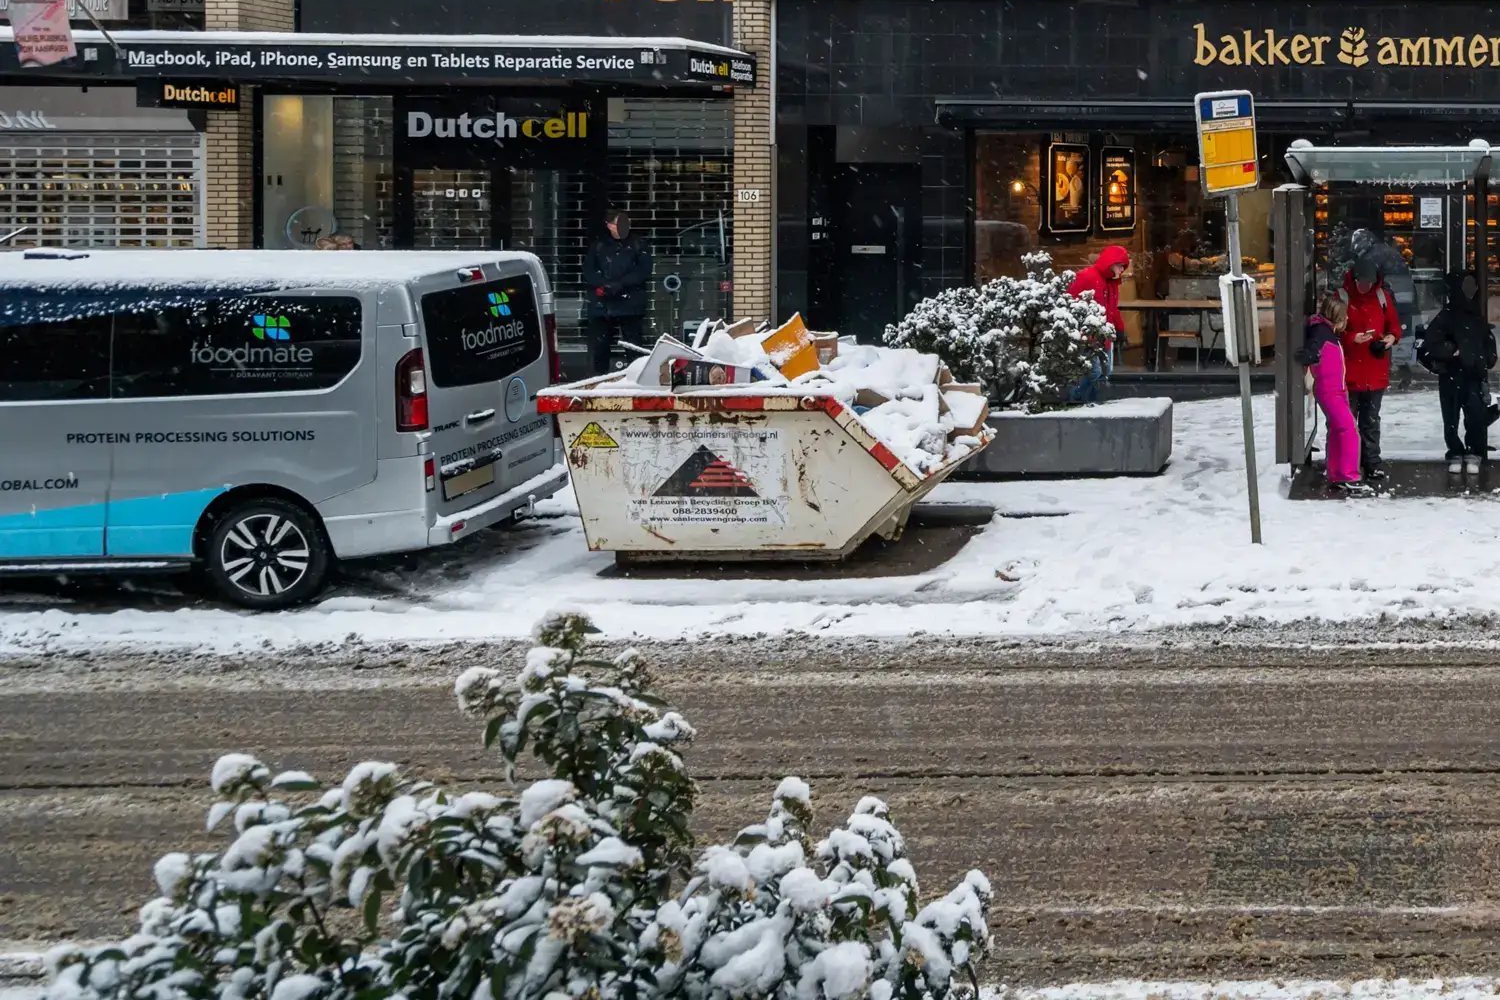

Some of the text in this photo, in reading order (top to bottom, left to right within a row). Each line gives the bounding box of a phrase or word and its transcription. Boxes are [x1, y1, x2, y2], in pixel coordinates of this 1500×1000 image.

[1194, 23, 1331, 66] bakker
[128, 50, 635, 71] Macbook, iPad, iPhone, Samsung en Tablets Reparatie Service
[690, 58, 728, 76] Dutchcell
[164, 84, 235, 104] Dutchcell
[408, 111, 587, 139] Dutchcell
[740, 190, 757, 201] 106
[461, 319, 525, 351] foodmate
[190, 340, 313, 364] foodmate
[66, 430, 315, 444] PROTEIN PROCESSING SOLUTIONS
[440, 417, 549, 465] PROTEIN PROCESSING SOLUTIONS
[0, 478, 79, 491] OBAL.COM
[650, 498, 688, 506] Leeuwen
[734, 498, 760, 508] Groep
[672, 507, 738, 515] 088-2839400
[649, 515, 768, 524] www.vanleeuwengroep.com
